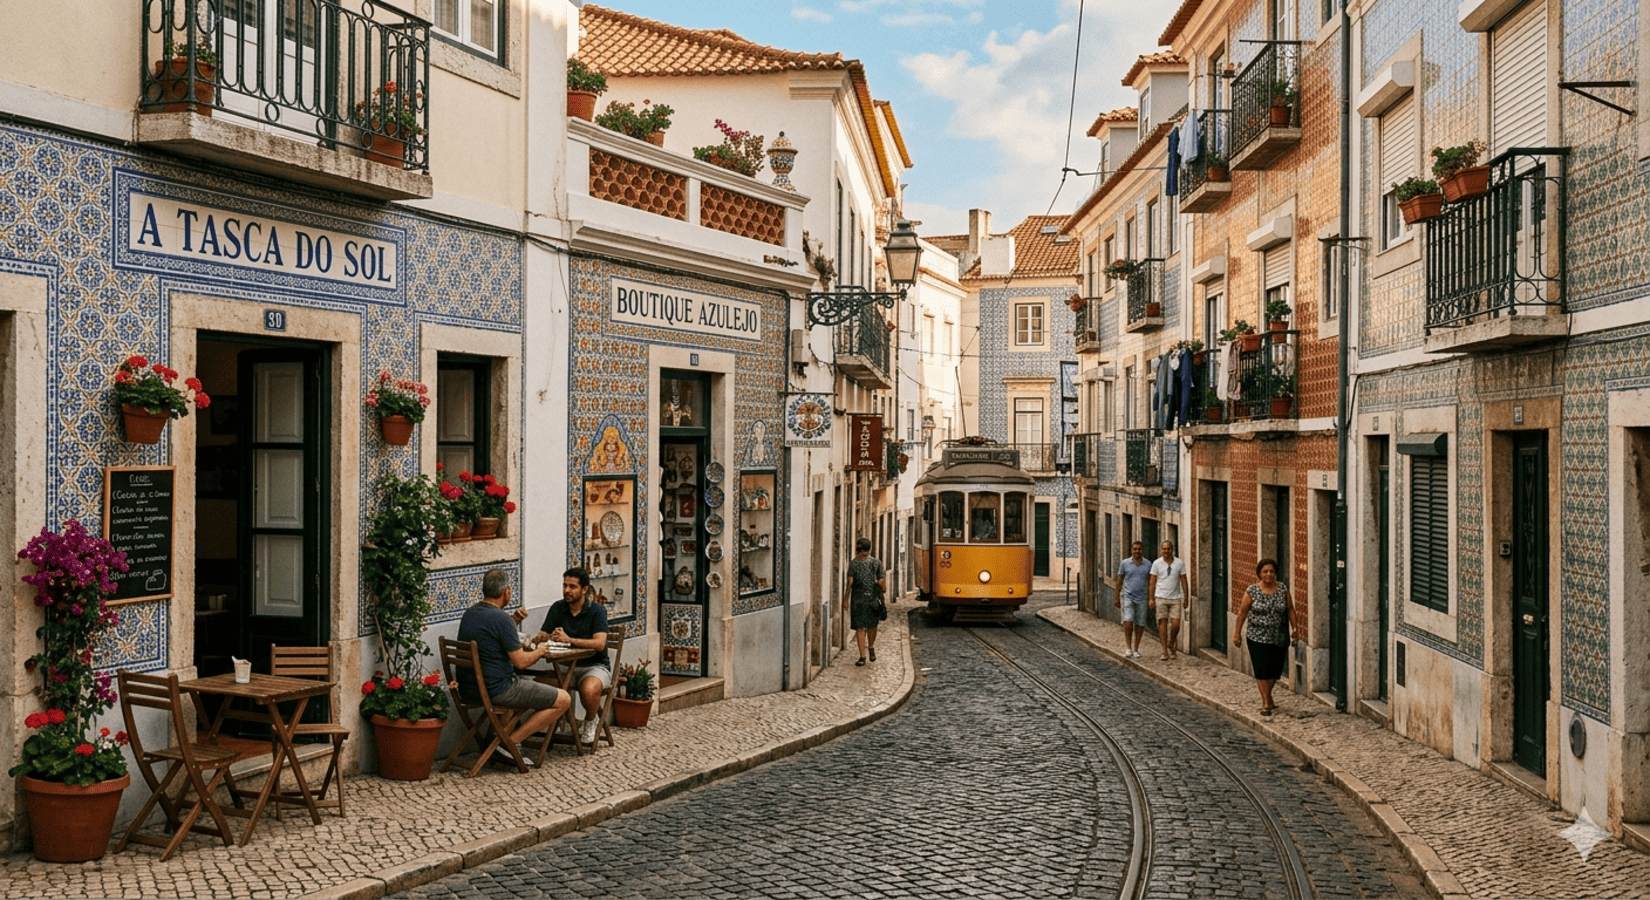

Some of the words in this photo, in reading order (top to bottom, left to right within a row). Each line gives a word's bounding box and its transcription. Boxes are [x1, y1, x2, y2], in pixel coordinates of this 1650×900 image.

[137, 202, 163, 247] A
[177, 208, 284, 266] TASCA
[295, 230, 333, 273] DO
[344, 240, 392, 283] SOL
[617, 287, 693, 325] BOUTIQUE
[698, 301, 757, 333] AZULEJO
